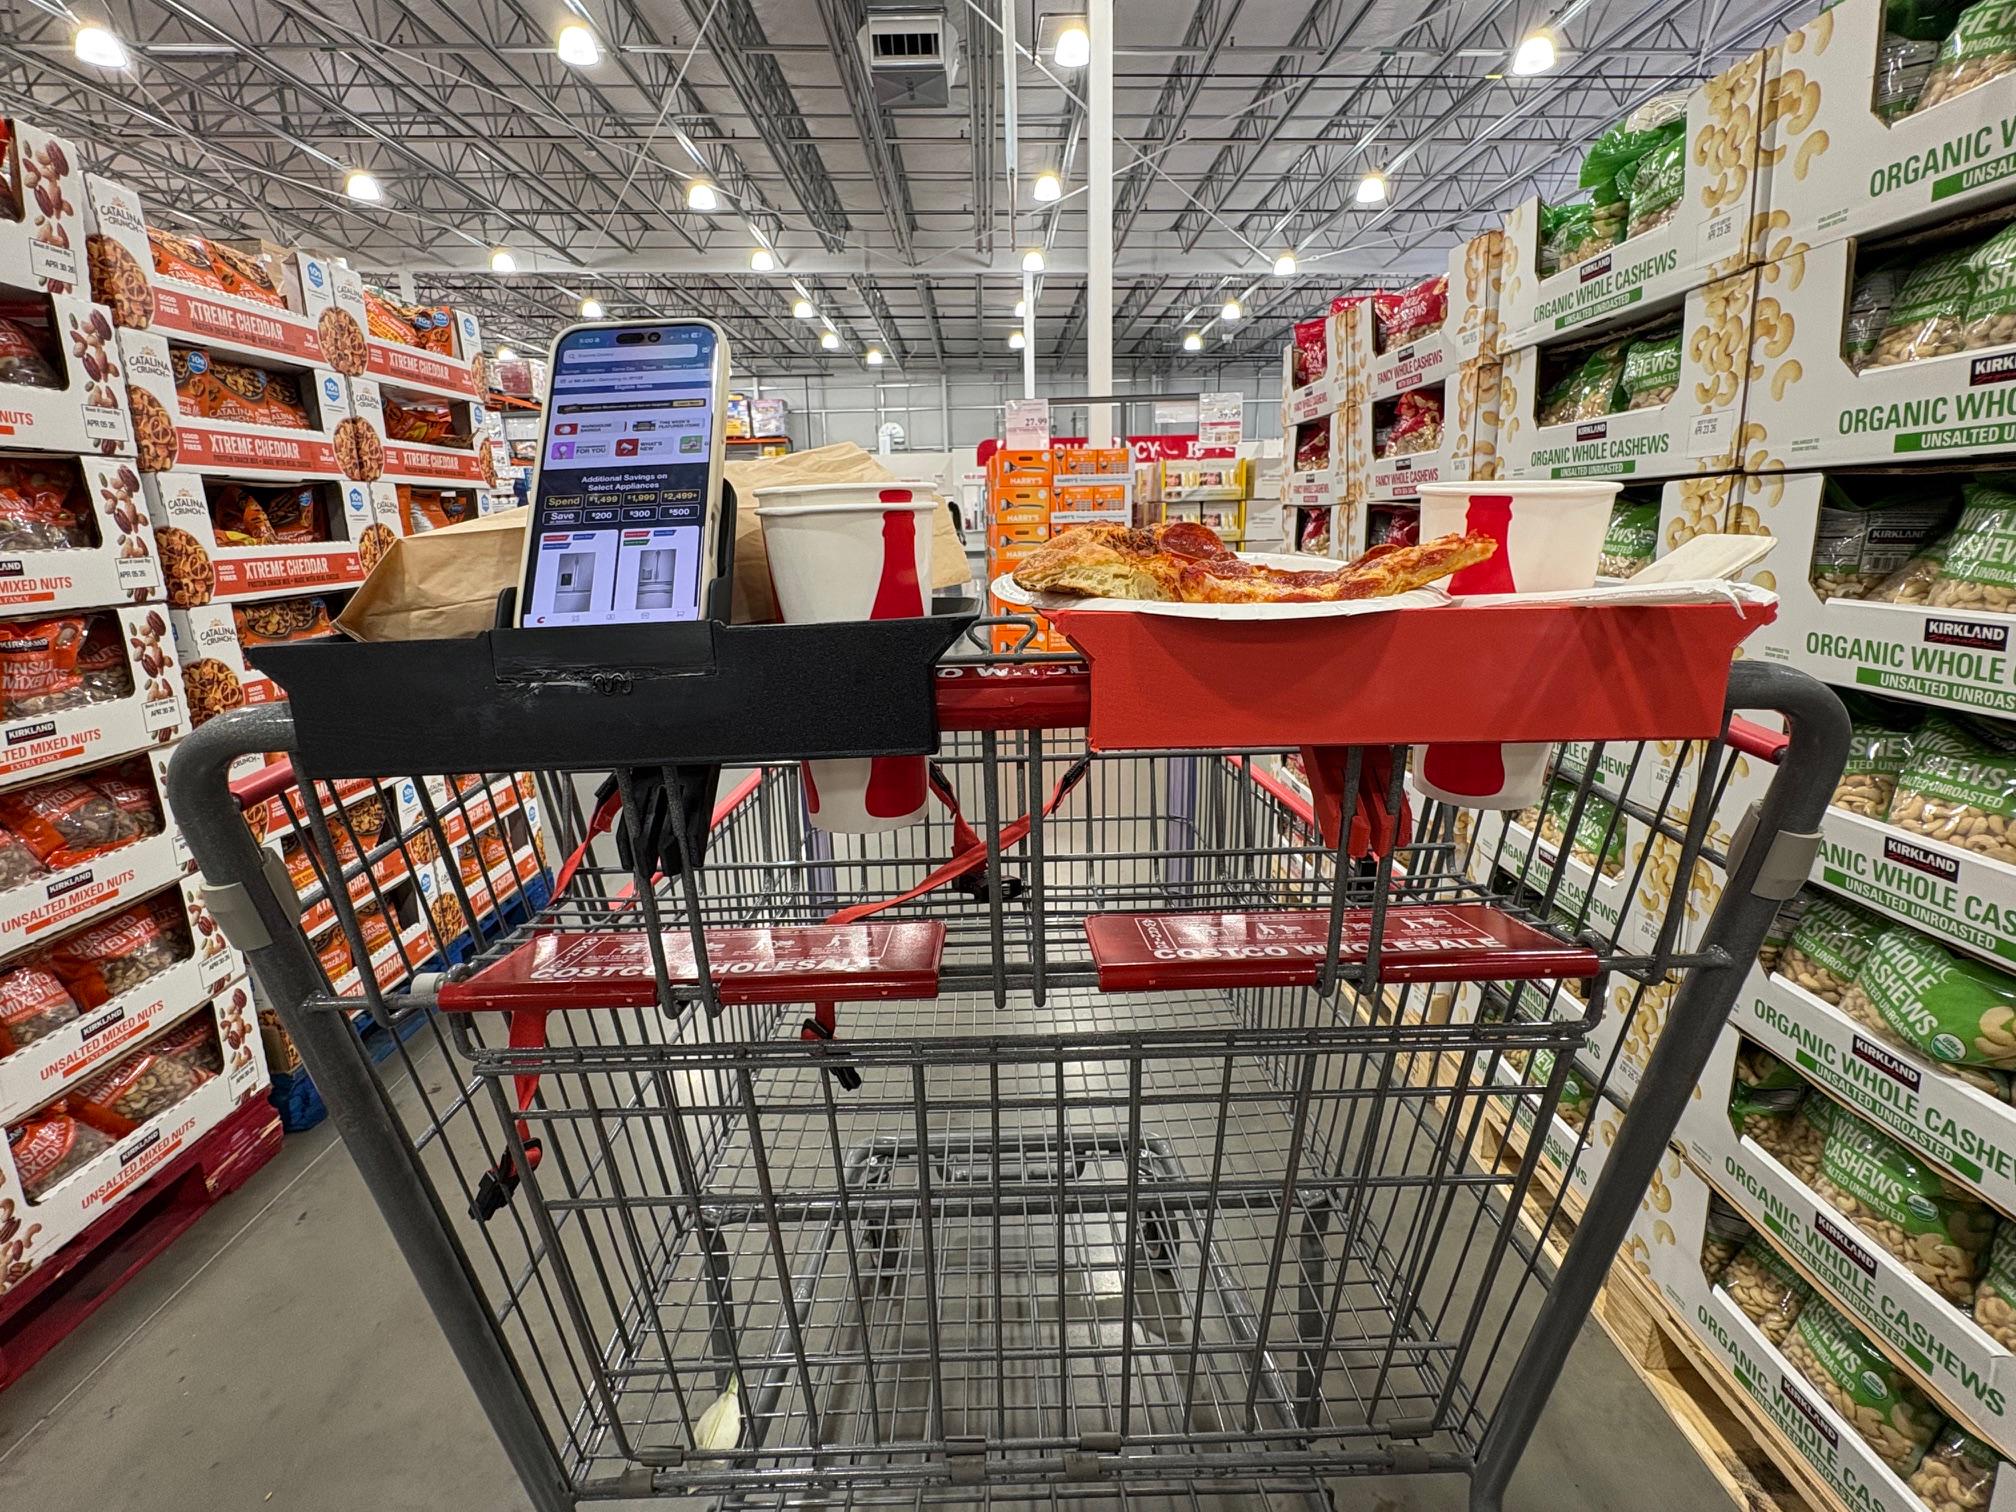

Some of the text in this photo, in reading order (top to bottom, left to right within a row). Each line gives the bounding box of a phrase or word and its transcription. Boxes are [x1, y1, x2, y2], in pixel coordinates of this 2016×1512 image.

[1870, 126, 1993, 197] ORGANIC
[100, 205, 144, 227] CATALINA
[1533, 249, 1677, 324] ORGANIC WHOLE CASHEWS
[186, 299, 236, 329] XTREME
[236, 314, 284, 341] CHEDDAR
[1564, 307, 1593, 325] UNSALTED
[129, 356, 170, 372] CATALINA
[136, 367, 166, 377] CRUNCH
[388, 351, 449, 380] XTREME CHEDDAR
[1377, 369, 1395, 385] FANCY
[1394, 362, 1413, 380] WHOLE
[1413, 349, 1443, 372] CASHEWS
[1025, 417, 1047, 427] 27.99
[1577, 424, 1607, 436] KIRKLAND
[1839, 397, 1948, 435] ORGANIC
[209, 434, 300, 459] XTREME CHEDDAR
[1530, 433, 1669, 467] ORGANIC WHOLE CASHEWS
[1921, 427, 1999, 448] UNSALTED
[403, 452, 459, 470] XTREME CHEDDAR
[1560, 463, 1624, 478] UNSALTED UNROASTED
[582, 475, 622, 483] Additional
[624, 474, 655, 483] Savings
[588, 482, 660, 491] Select Appliances
[1009, 477, 1043, 485] HARRY'S
[1376, 468, 1439, 488] FANCY WHOLE CASHEWS
[168, 498, 205, 510] CATALINA
[548, 497, 580, 507] Spend
[551, 512, 574, 521] Save
[244, 560, 287, 581] XTREME
[286, 557, 329, 576] CHEDDAR
[0, 576, 72, 594] MIXED NUTS
[200, 629, 237, 642] CATALINA
[206, 636, 233, 646] CRUNCH
[1928, 620, 2006, 641] KIRKLAND
[1806, 631, 2007, 684] ORGANIC WHOLE
[1880, 672, 1950, 697] UNSALTED
[8, 723, 54, 739] KIRKLAND
[30, 728, 102, 755] MIXED NUTS
[10, 758, 36, 771] EXTRA
[1929, 780, 2005, 809] UNROASTED
[1887, 839, 1957, 873] KIRKLAND
[49, 872, 92, 893] KIRKLAND
[1816, 839, 1961, 904] ANIC WHOLE
[1, 869, 135, 934] UNSALTED MIXED NUTS
[1845, 877, 1909, 914] UNSALTED
[1911, 902, 1997, 951] UNROASTED
[1809, 899, 1872, 940] WHOLE
[68, 914, 138, 956] UNSALTED
[1153, 945, 1289, 960] COSTCO
[1876, 932, 1939, 996] WHOLE
[530, 964, 657, 981] COSTCO
[1868, 953, 1939, 1037] ASHEWS
[82, 1009, 124, 1037] KIRKLAND
[40, 1000, 165, 1082] UNSALTED MIXED NUTS
[1855, 1037, 1919, 1086] KIRKLAND
[1753, 998, 2016, 1185] ORGANIC WHOLE CASHE
[1815, 1062, 1954, 1163] UNSALTED UNROASTED
[121, 1131, 160, 1162] KIRKLAND
[1832, 1113, 1892, 1167] WHOLE
[81, 1117, 197, 1210] UNSALTED MIXED NUTS
[1824, 1135, 1905, 1205] CASHEWS
[1849, 1177, 1906, 1224] UNROASTED
[1818, 1214, 1876, 1271] KIRKLAND
[1725, 1155, 2008, 1418] ORGANIC WHOLE CASHEWS
[1781, 1228, 1908, 1351] UNSALTED UNROASTED
[1697, 1304, 1839, 1467] ORGANIC WHOLE
[1751, 1387, 1802, 1452] UNSALTED
[1783, 1377, 1839, 1442] KIRKLAND
